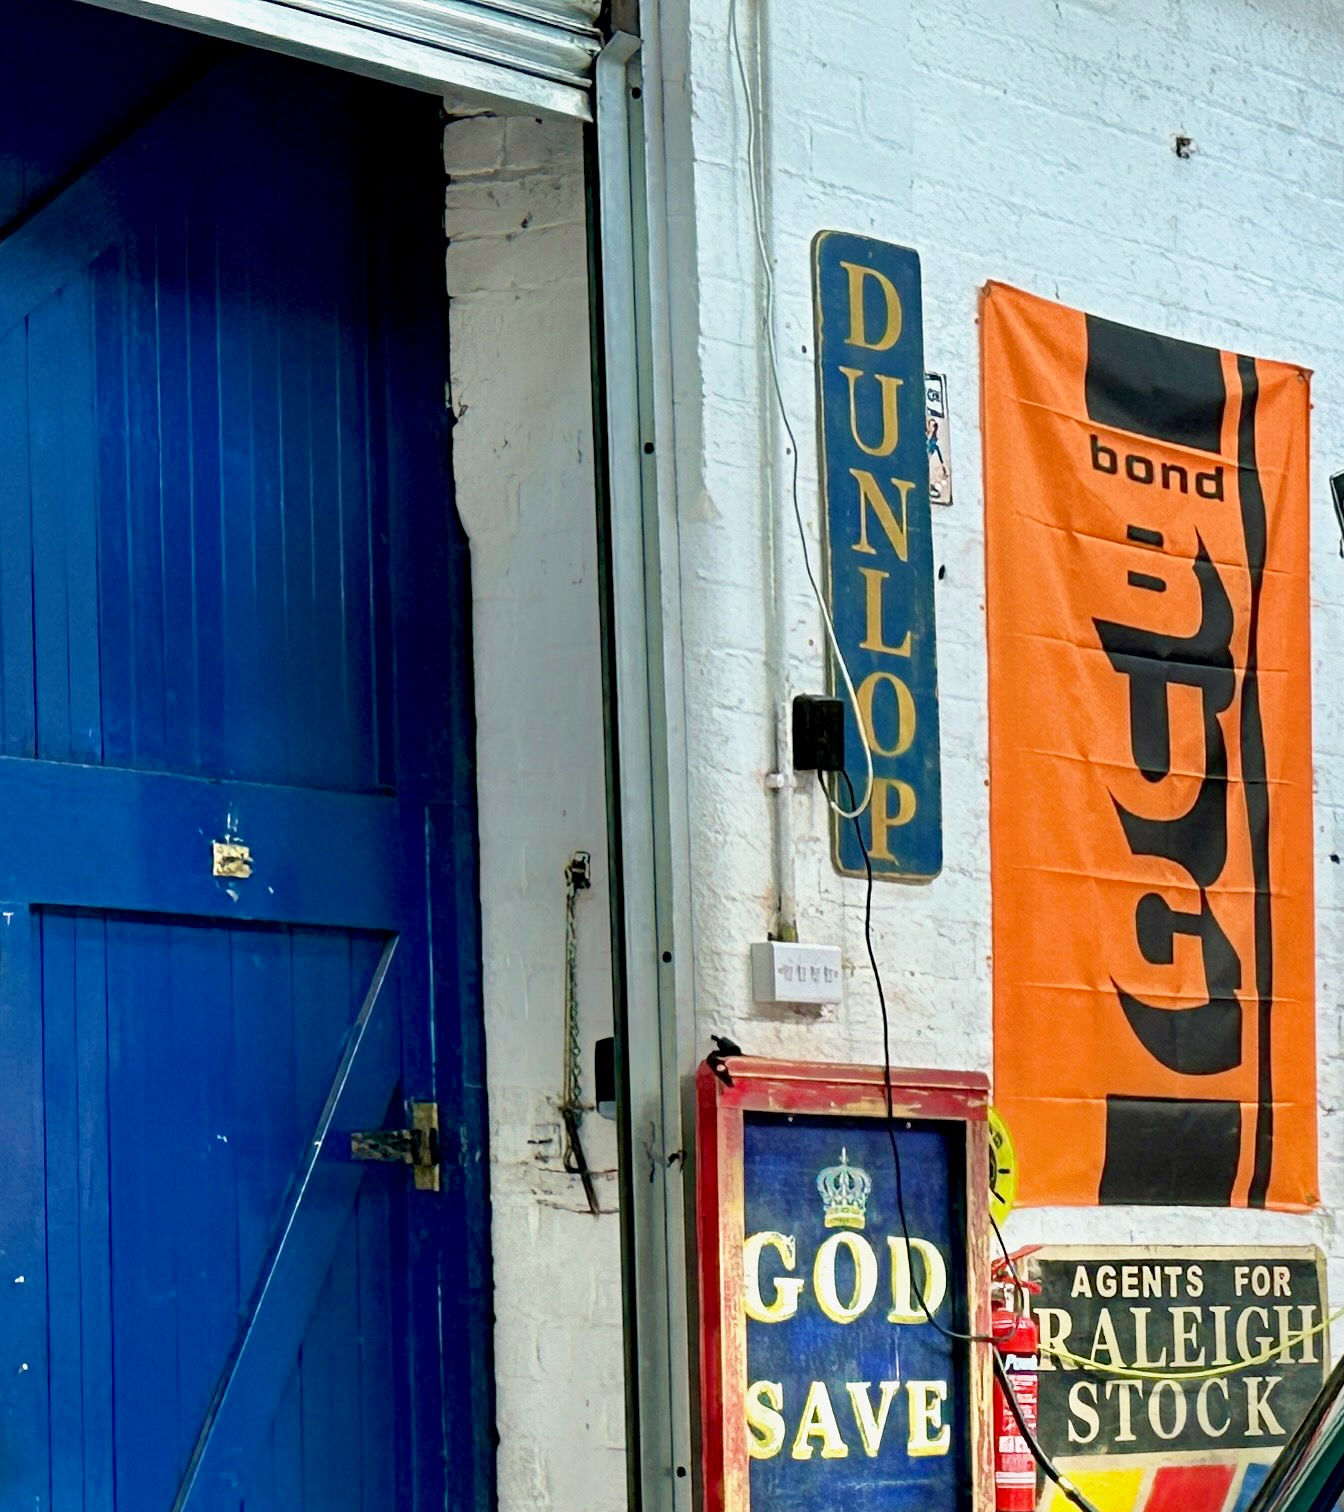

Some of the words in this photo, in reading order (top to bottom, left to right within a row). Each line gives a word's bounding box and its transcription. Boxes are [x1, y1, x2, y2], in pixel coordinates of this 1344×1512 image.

[1089, 435, 1224, 502] bond
[839, 260, 917, 866] DUNLOP
[743, 1230, 949, 1324] GOD
[1070, 1264, 1204, 1298] AGENTS
[1234, 1265, 1292, 1297] FOR
[1033, 1304, 1320, 1371] RALEIGH
[746, 1380, 951, 1461] SAVE
[1067, 1376, 1286, 1444] STOCK
